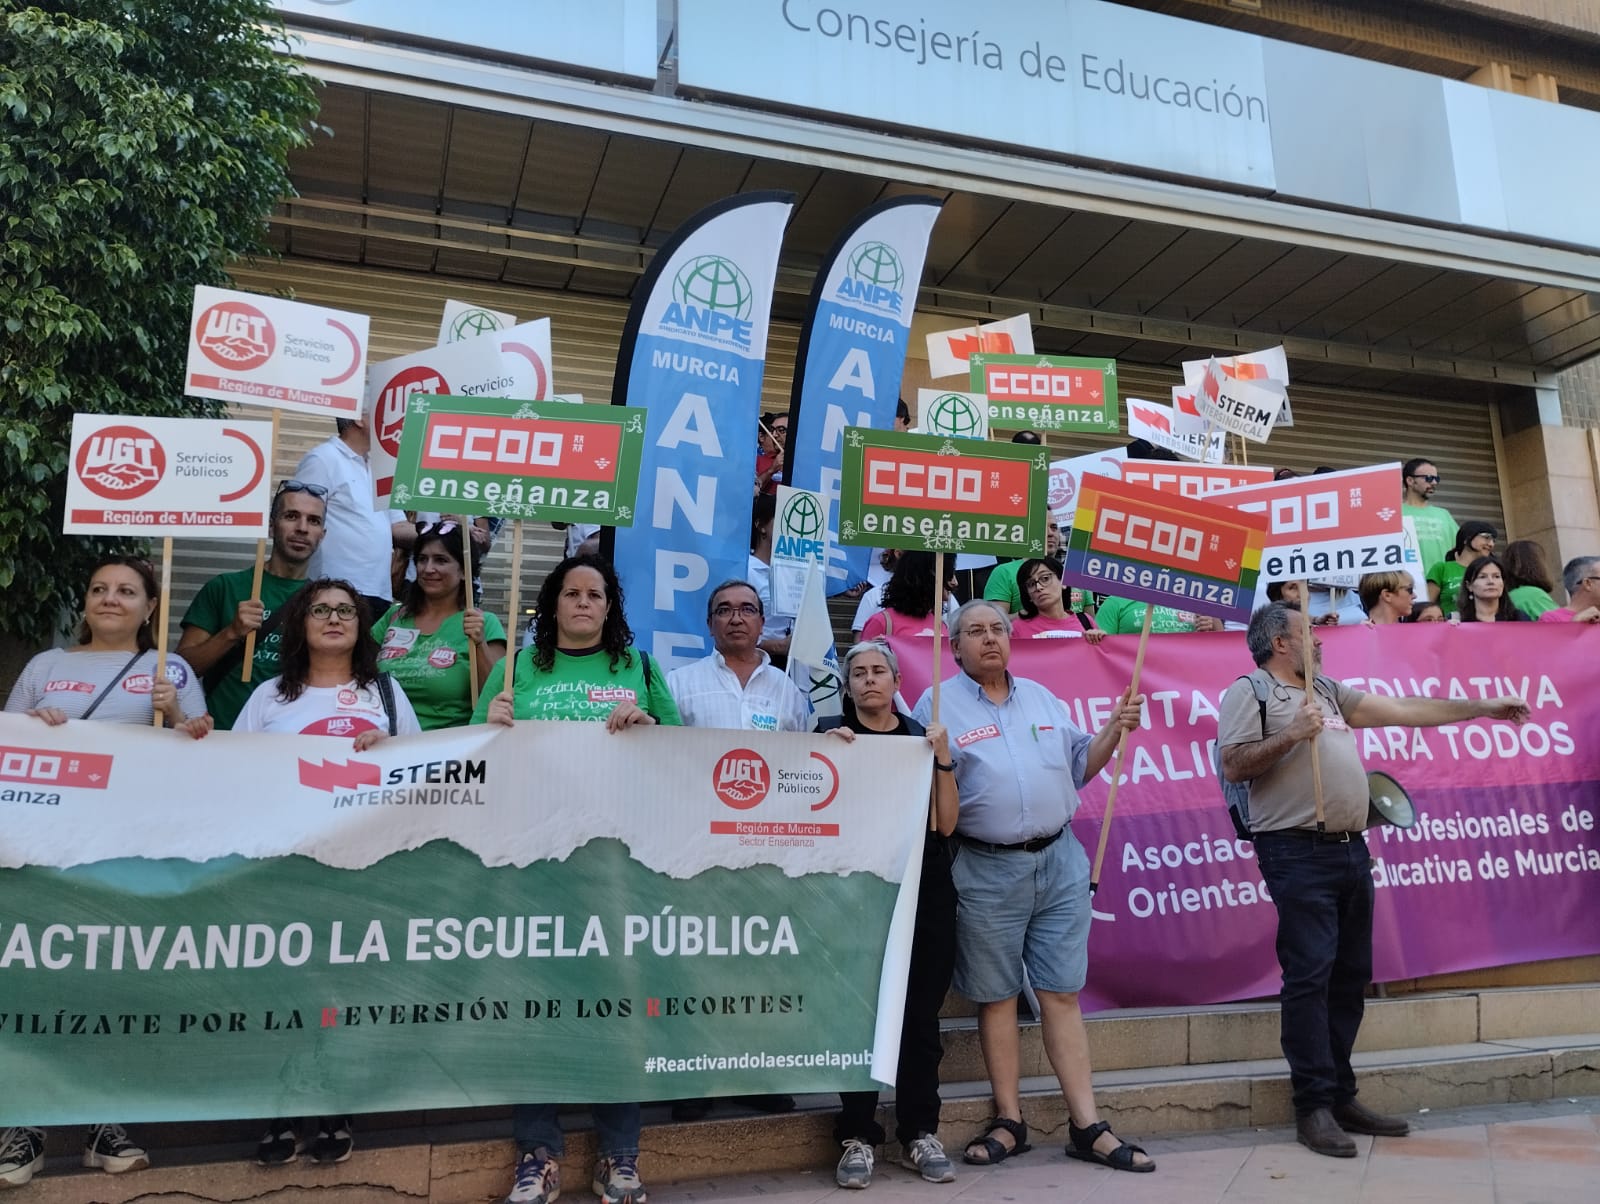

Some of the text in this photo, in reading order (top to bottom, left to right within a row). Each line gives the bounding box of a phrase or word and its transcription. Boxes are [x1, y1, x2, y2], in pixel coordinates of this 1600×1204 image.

[782, 0, 1266, 123] Consejería de Educación
[837, 276, 903, 313] ANPE
[207, 309, 268, 338] UGT
[660, 302, 753, 346] ANPE
[829, 313, 895, 344] MURCIA
[283, 346, 331, 364] Públicos
[285, 333, 335, 351] Servicios
[652, 349, 740, 386] MURCIA
[218, 377, 332, 407] Región de Murcia
[461, 375, 515, 397] Servicios
[989, 371, 1071, 397] CCOO
[988, 404, 1104, 423] enseñanza
[1218, 394, 1272, 427] STERM
[428, 425, 564, 467] CCOO
[1173, 427, 1220, 450] ERM
[92, 437, 156, 468] UGT
[176, 452, 232, 466] Servicios
[175, 465, 229, 479] Públicos
[868, 460, 983, 502] CCOO
[419, 477, 611, 510] enseñanza
[102, 509, 234, 527] Región de Murcia
[862, 511, 1026, 543] enseñanza
[1096, 507, 1204, 562] CCOO
[775, 535, 825, 561] ANPE
[1266, 540, 1403, 577] eñanza
[1086, 556, 1234, 606] enseñanza
[46, 680, 79, 692] UGT
[536, 681, 583, 696] ESCUELA
[591, 689, 636, 700] CCOO
[327, 718, 353, 729] UGT
[752, 713, 778, 725] ANP
[957, 723, 996, 745] CCOO
[0, 752, 62, 780] OO
[1099, 721, 1576, 786] CALI ARA TODOS
[387, 760, 487, 785] STERM
[719, 758, 763, 781] UGT
[778, 769, 824, 781] Servicios
[333, 788, 486, 808] INTERSINDICAL
[778, 782, 821, 794] Públicos
[736, 823, 822, 835] Región de Murcia
[1561, 804, 1595, 832] de
[738, 836, 815, 848] Sector Enseñanza
[1371, 854, 1473, 889] ducativa
[1478, 851, 1510, 880] de
[1514, 844, 1600, 878] Murcia
[0, 905, 800, 971] ACTIVANDO LA ESCUELA PÚBLICA
[179, 1007, 248, 1034] POR
[264, 1009, 305, 1031] LA
[320, 997, 509, 1029] REVERSIÓN
[525, 998, 562, 1020] DE
[576, 997, 633, 1019] LOS
[647, 994, 805, 1018] RECORTES!
